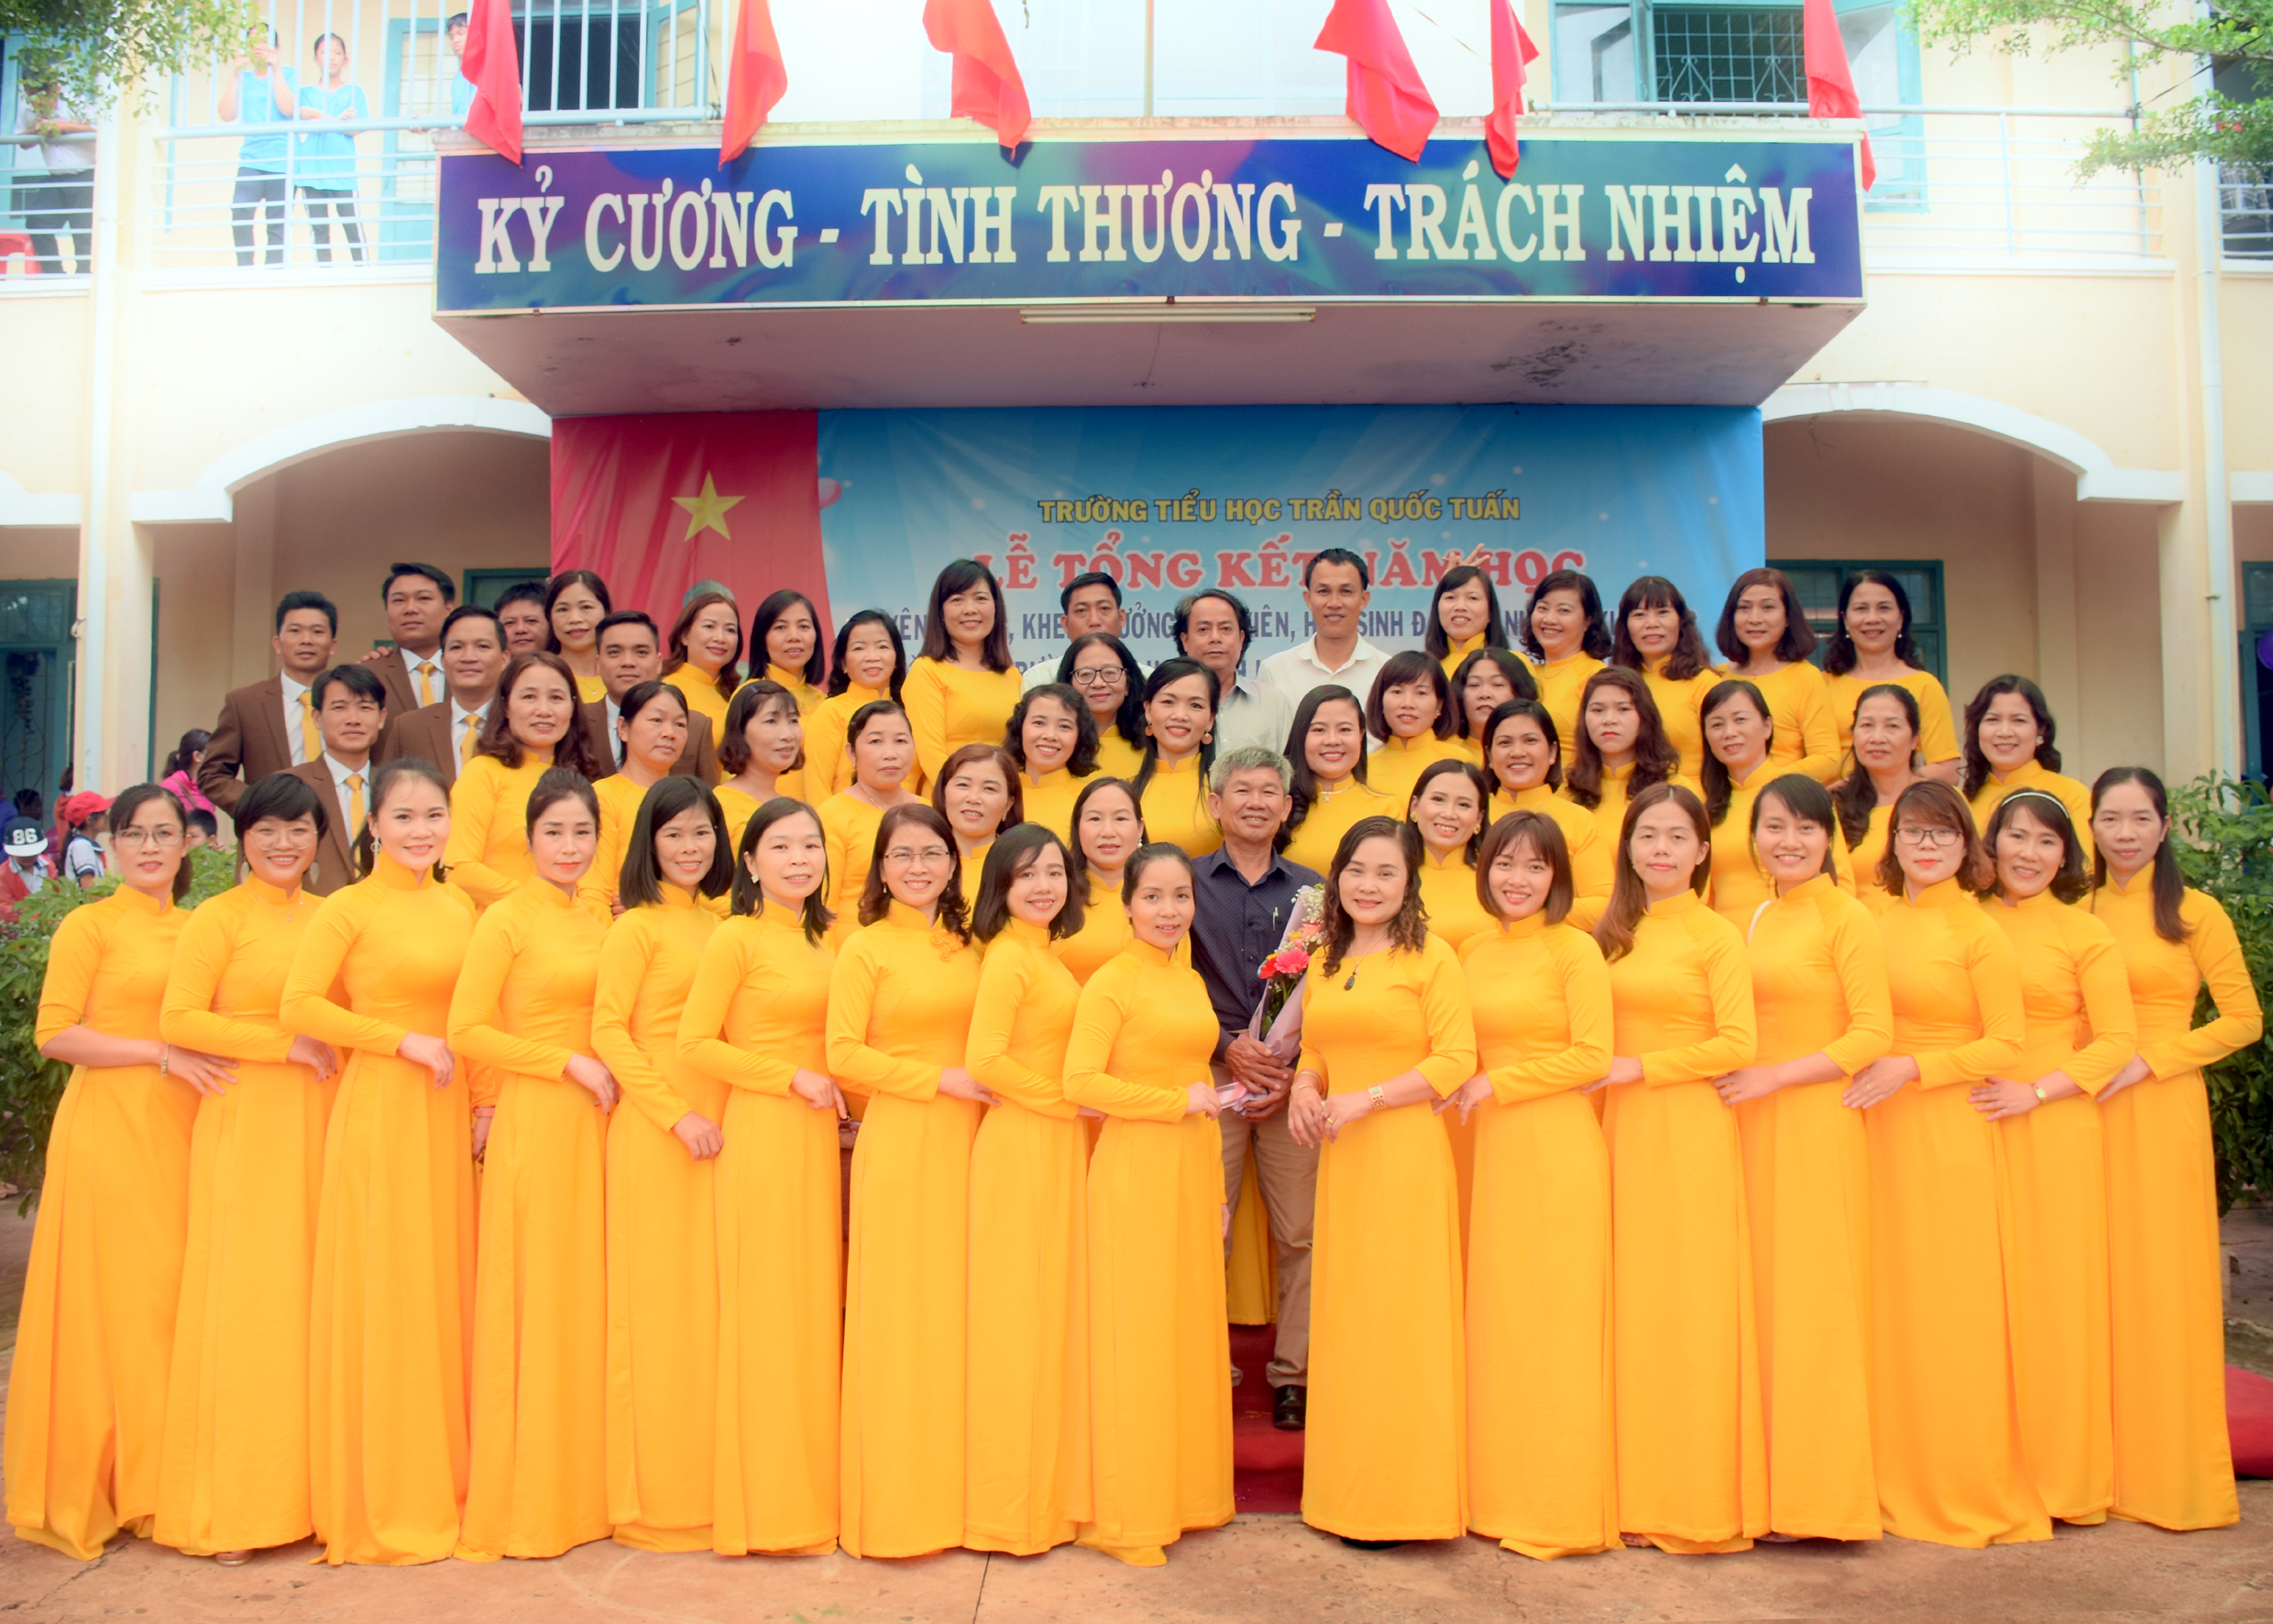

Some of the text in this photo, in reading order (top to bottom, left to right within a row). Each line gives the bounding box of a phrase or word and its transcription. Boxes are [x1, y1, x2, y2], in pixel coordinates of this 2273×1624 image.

[475, 165, 565, 274] KỶ
[584, 178, 798, 272] CƯƠNG
[861, 163, 1016, 266] TÌNH
[1037, 169, 1302, 264] THƯƠNG
[1363, 159, 1587, 263] TRÁCH
[1606, 163, 1816, 284] NHIỆM
[1038, 488, 1521, 525] TRƯỜNG TIỂU HỌC TRẦN QUỐC TUẤN
[1053, 531, 1202, 588] TỔNG
[1023, 613, 1070, 640] KHE
[1250, 604, 1295, 642] IÊN,
[1357, 610, 1403, 636] SINH
[12, 828, 38, 845] 86
